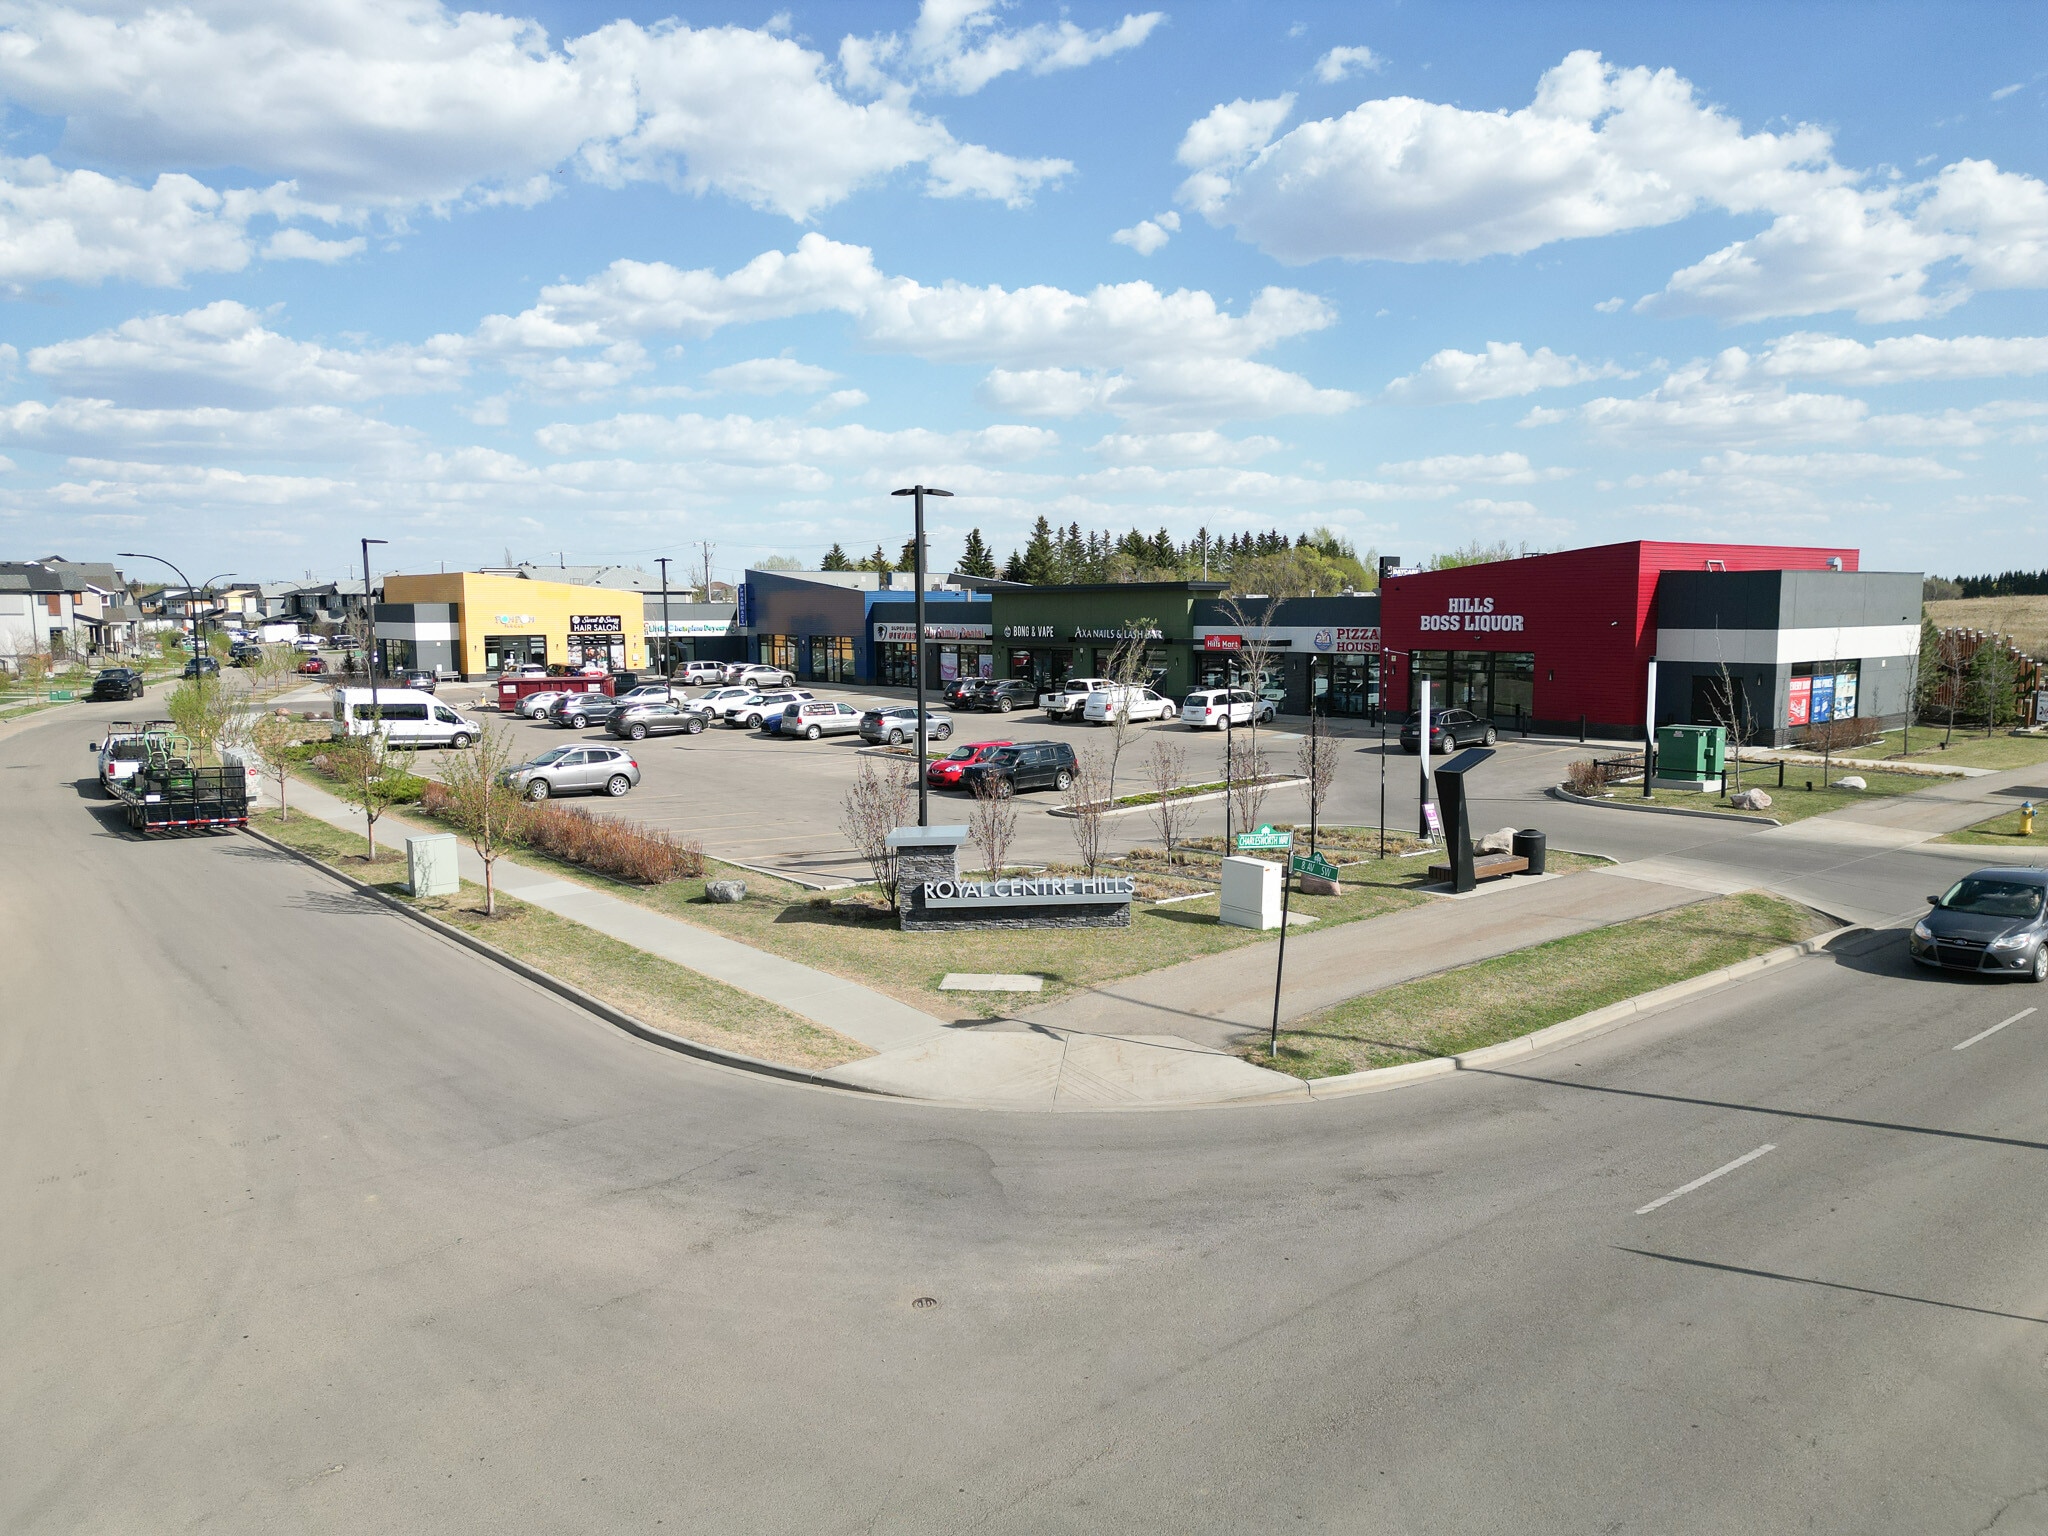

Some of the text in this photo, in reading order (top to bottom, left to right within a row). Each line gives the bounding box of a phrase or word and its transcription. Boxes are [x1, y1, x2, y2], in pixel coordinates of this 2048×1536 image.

[1448, 598, 1494, 613] HILLS
[593, 623, 619, 631] SALON
[1420, 615, 1524, 632] BOSS LIQUOR
[889, 632, 917, 640] FITNES
[1013, 625, 1054, 638] BONG & VAPE
[1093, 629, 1114, 639] NAILS
[1116, 629, 1122, 639] &
[1124, 629, 1143, 639] LASH
[1337, 629, 1379, 640] PIZZA
[1207, 640, 1239, 648] Hills Mart
[1337, 642, 1379, 653] HOUSE
[1240, 836, 1289, 846] CHARLESWORTH WAY
[1301, 861, 1332, 877] 8 AV SW
[923, 875, 1136, 899] ROYAL CENTRE HILLS
